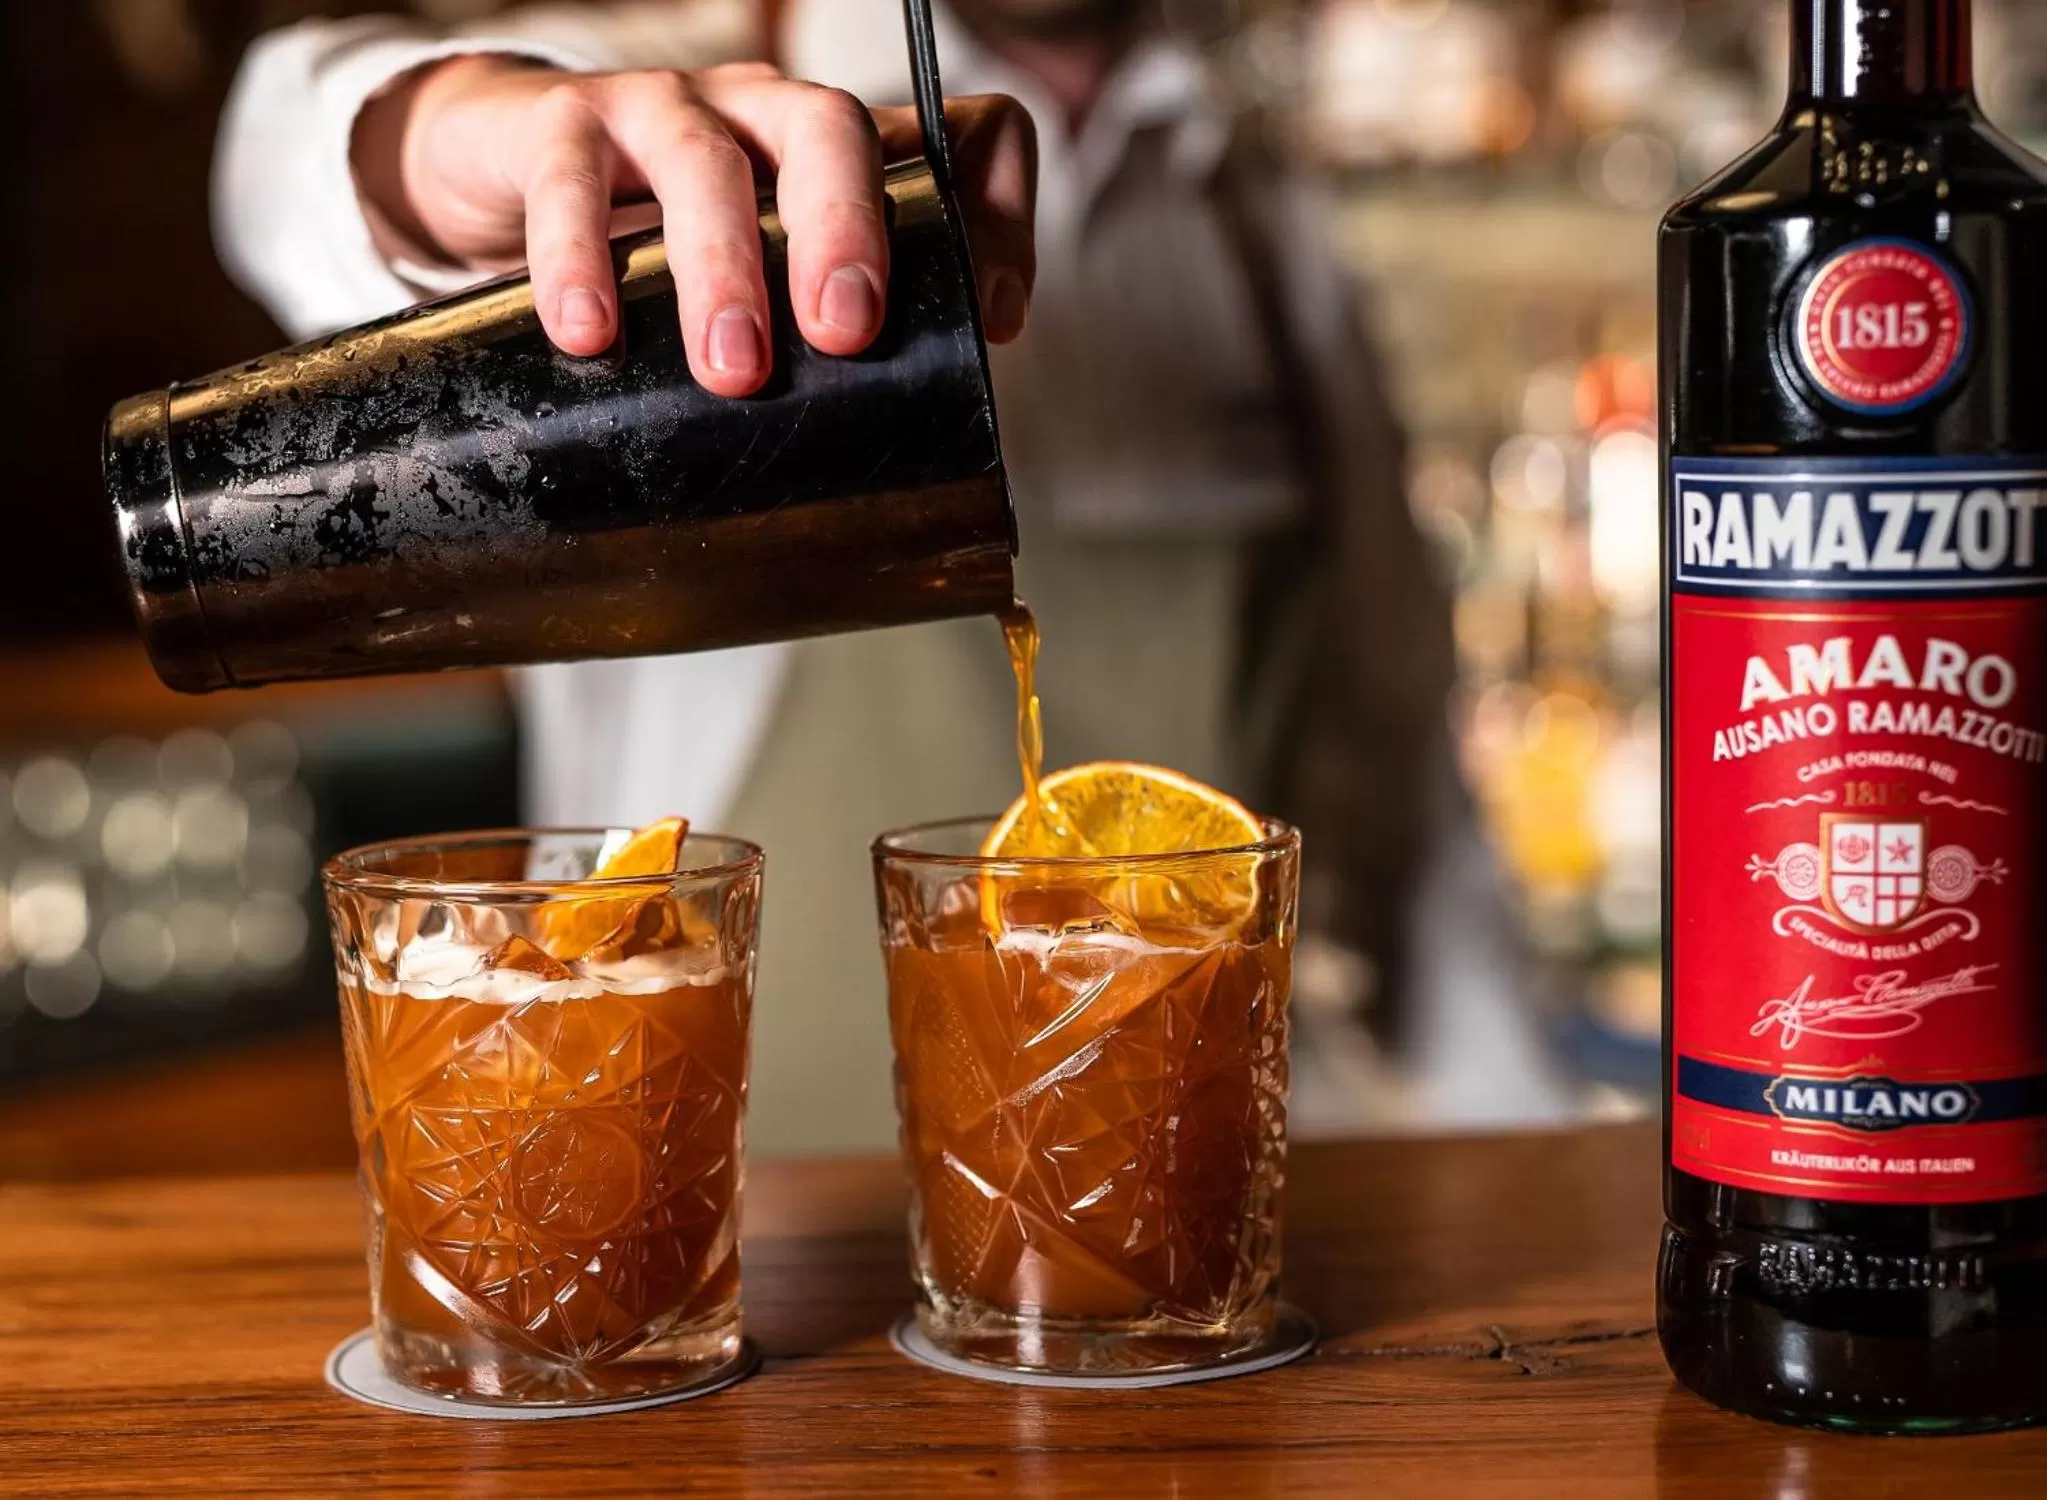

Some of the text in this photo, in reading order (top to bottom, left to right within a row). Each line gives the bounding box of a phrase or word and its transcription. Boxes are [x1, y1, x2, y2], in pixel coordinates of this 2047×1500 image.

[1838, 302, 1929, 349] 1815
[1683, 488, 2047, 571] RAMAZZOT
[1739, 635, 2016, 711] AMARO
[1713, 700, 2046, 763] AUSANO RAMAZZOTTI
[1796, 755, 1844, 783] CASA
[1844, 750, 1926, 772] FONDATA
[1871, 941, 1922, 961] DELLA
[1785, 1086, 1966, 1117] MILANO
[1884, 1158, 1917, 1174] AUS
[1919, 1157, 1976, 1173] ITALIEN
